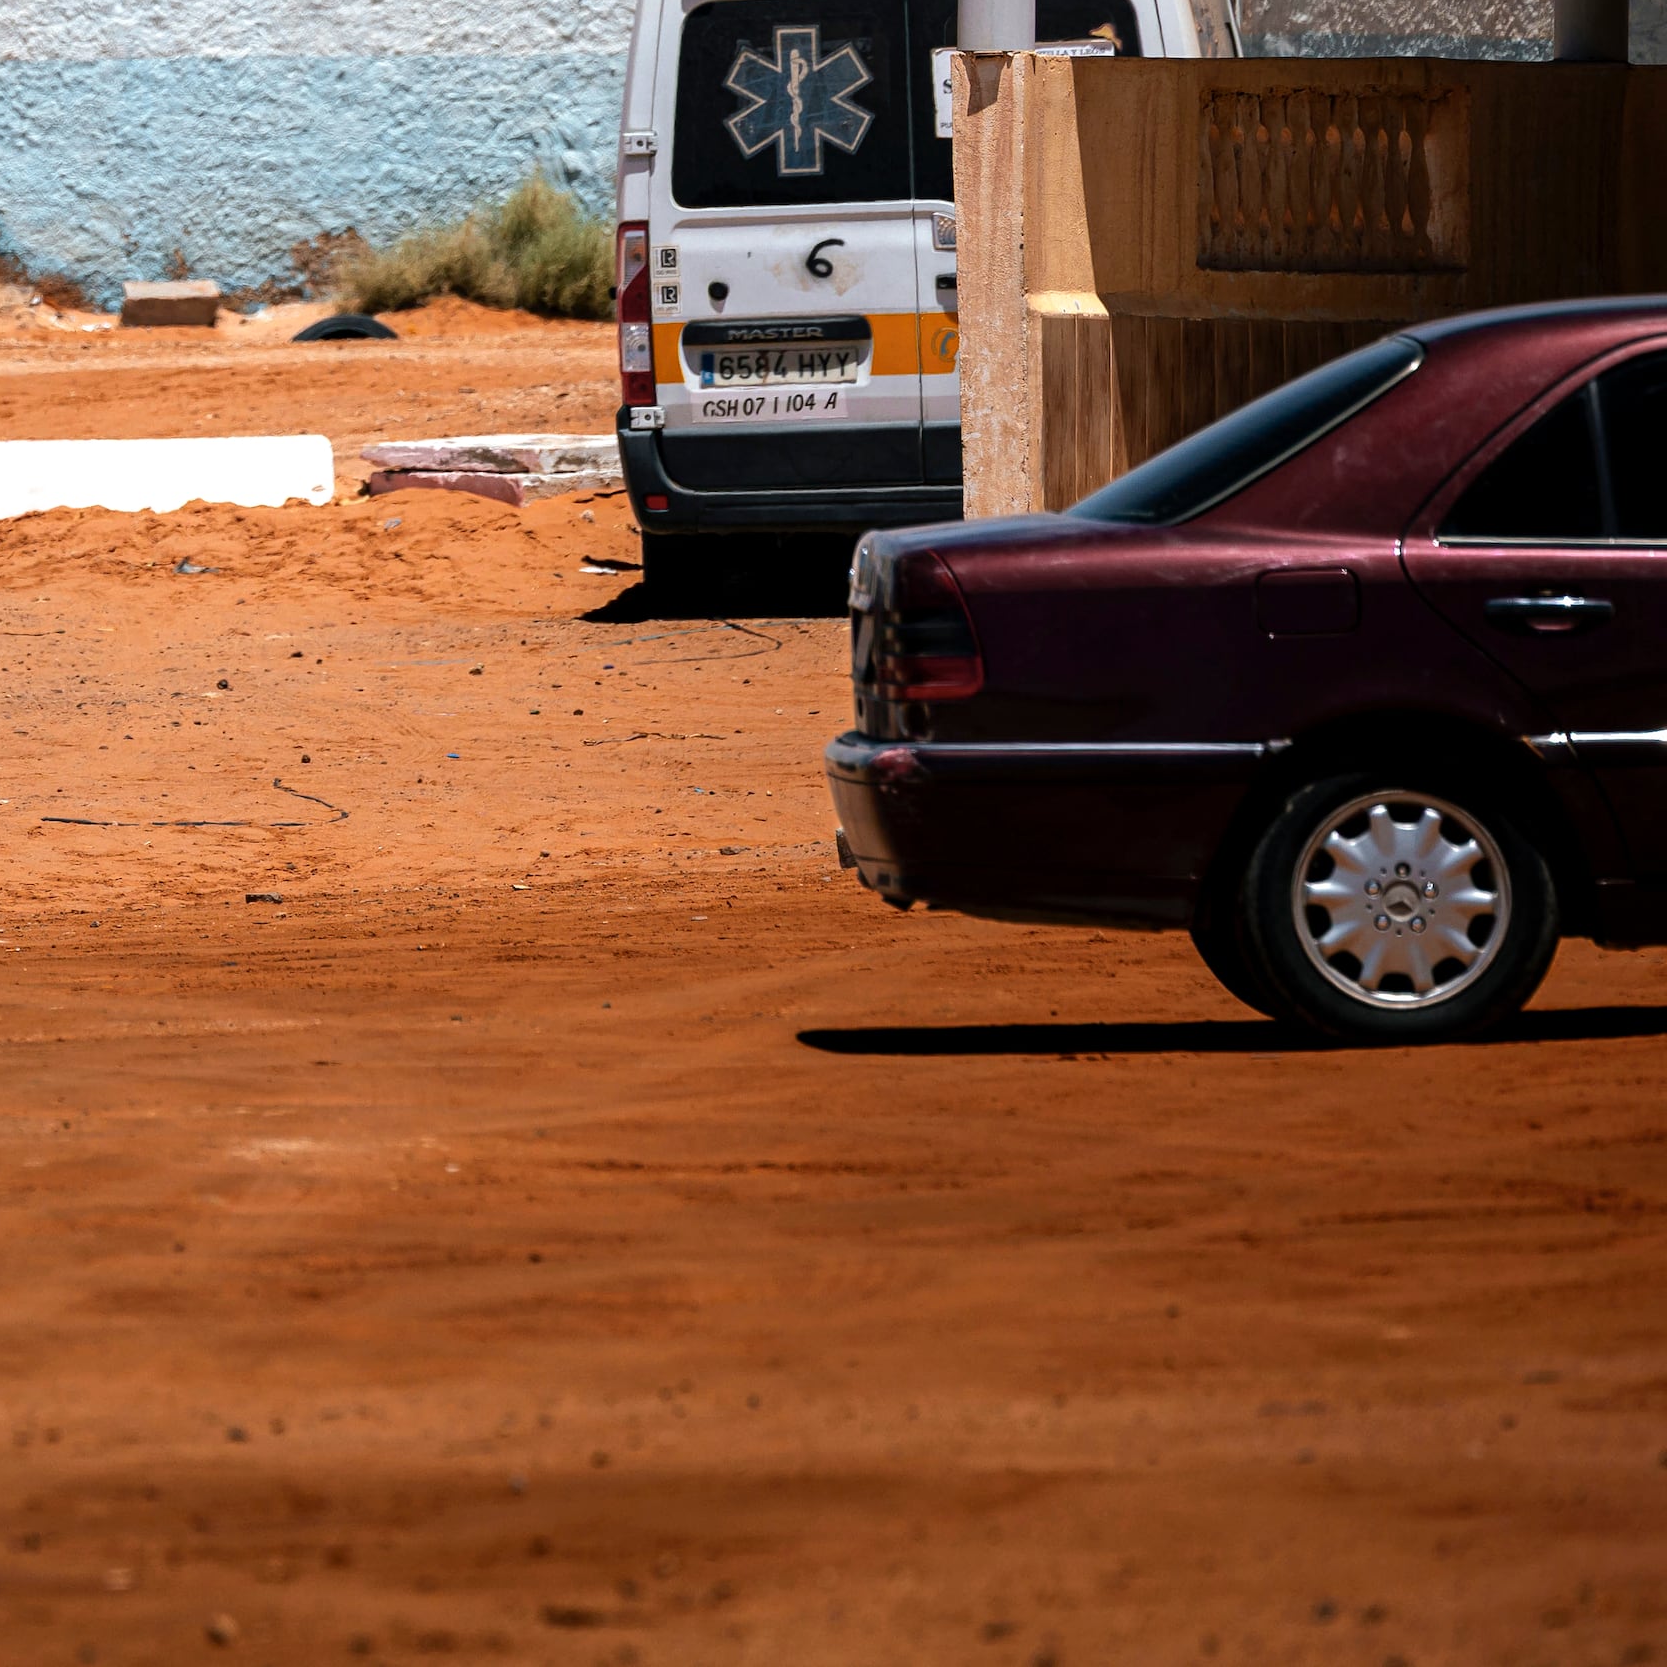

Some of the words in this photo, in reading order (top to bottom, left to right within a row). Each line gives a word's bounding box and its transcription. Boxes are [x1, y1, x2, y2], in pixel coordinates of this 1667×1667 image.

[805, 238, 845, 279] 6
[728, 326, 824, 341] MASTER
[718, 353, 788, 380] 6584
[798, 352, 850, 377] HYY
[742, 397, 765, 415] 07
[786, 393, 816, 413] 104
[824, 392, 838, 410] A
